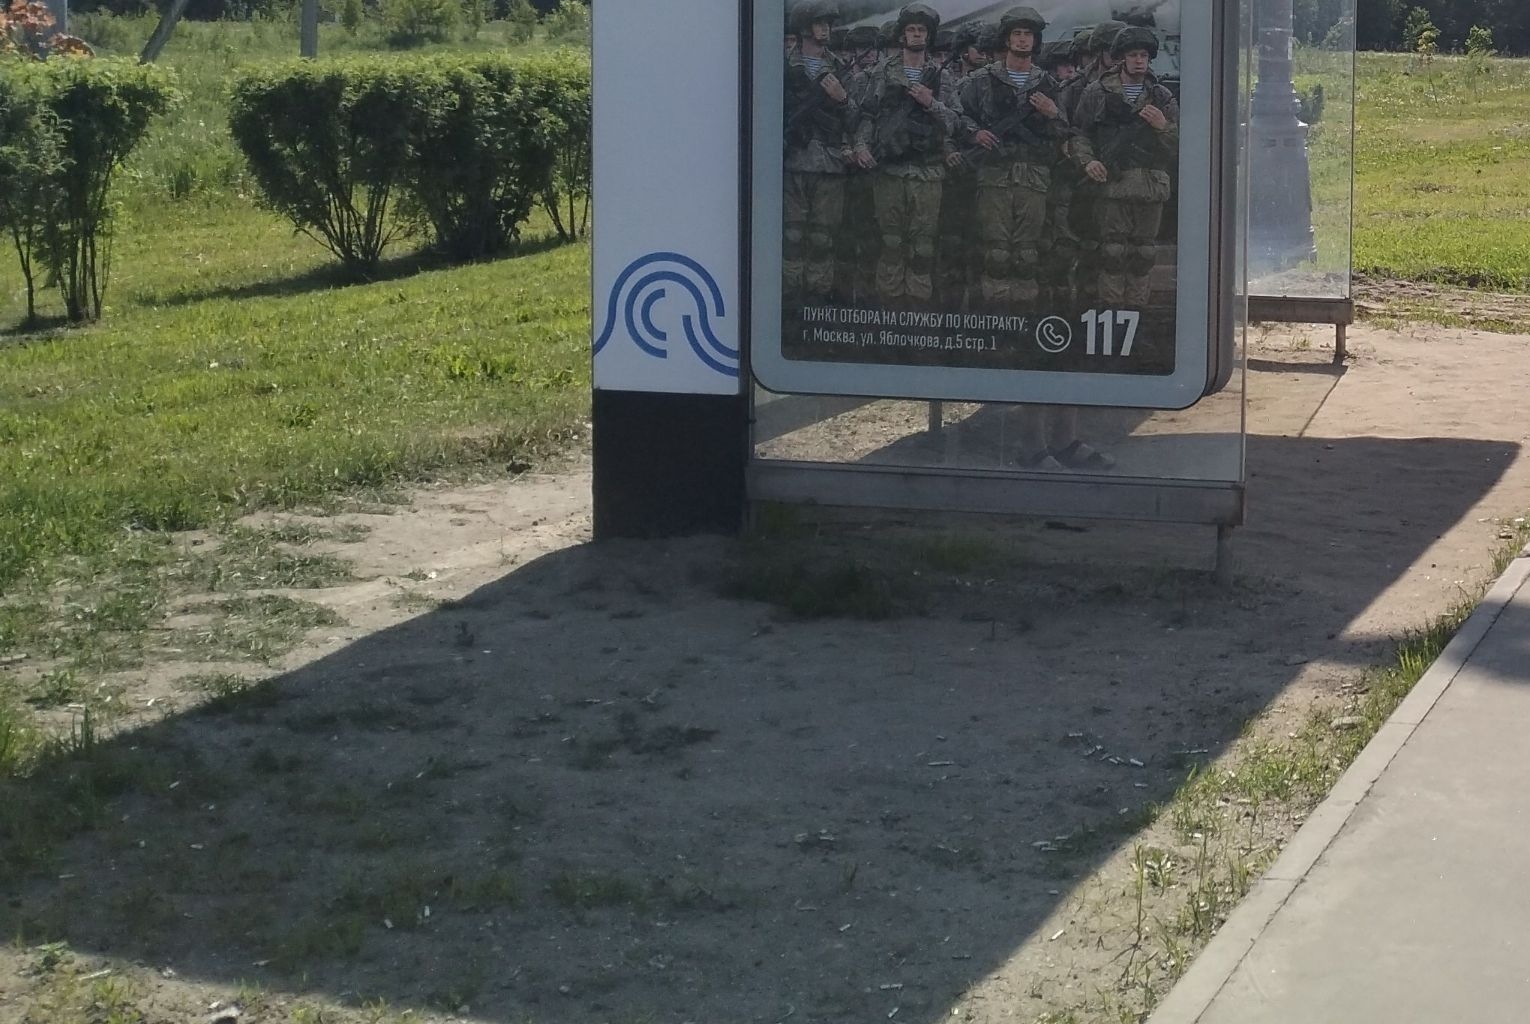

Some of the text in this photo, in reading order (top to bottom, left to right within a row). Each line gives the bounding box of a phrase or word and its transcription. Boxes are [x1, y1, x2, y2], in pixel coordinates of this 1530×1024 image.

[803, 306, 1028, 332] ПУНКТ ОТБОРА НА СЛУЖБУ ПО КОНТРАКТУ:
[802, 329, 811, 342] г.
[813, 327, 859, 345] Москва,
[860, 332, 877, 347] ул.
[944, 334, 963, 350] д.5
[965, 337, 988, 352] стр.
[991, 335, 997, 351] 1
[1080, 309, 1140, 356] 117
